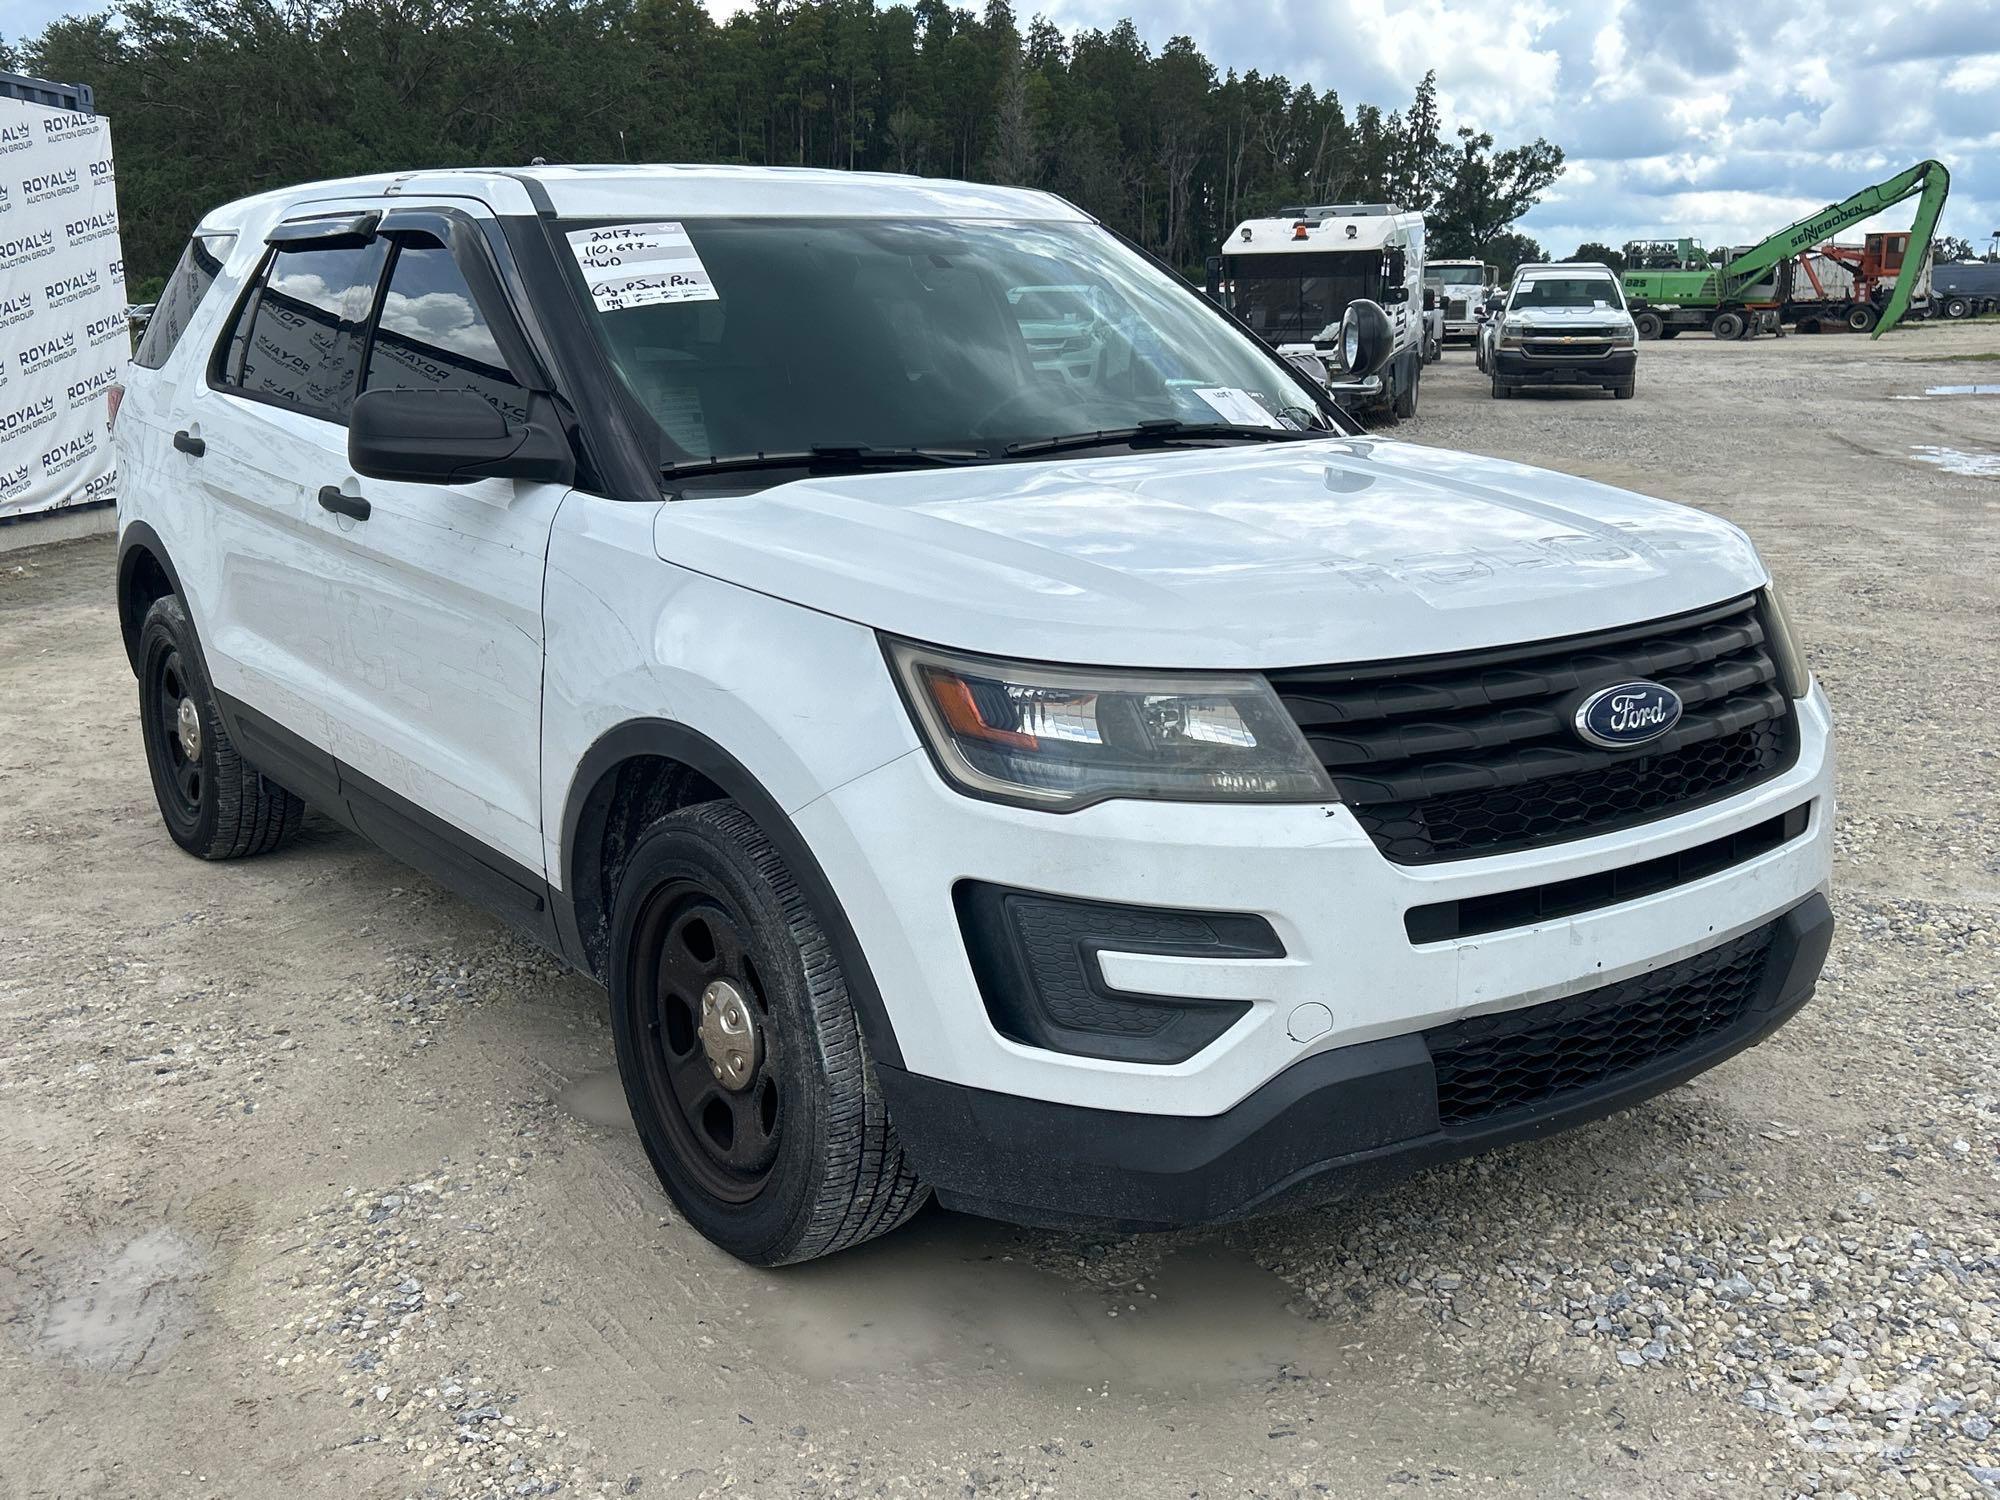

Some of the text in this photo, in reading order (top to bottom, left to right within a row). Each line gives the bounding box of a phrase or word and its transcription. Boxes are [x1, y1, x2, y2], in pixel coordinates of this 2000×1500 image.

[43, 113, 87, 133] ROYAL
[48, 126, 99, 143] AUCTION GROUP
[8, 140, 33, 153] GROUP
[89, 159, 115, 177] ROY
[93, 174, 115, 187] AUCTIO
[22, 172, 67, 195] ROYAL
[26, 184, 80, 206] AUCTION GROUP
[65, 214, 107, 238] ROYAL
[69, 225, 118, 248] AUCTION GROUP
[0, 234, 42, 259] ROYAL
[0, 246, 56, 271] AUCTION GROUP
[583, 256, 622, 268] 4WD
[45, 274, 88, 300] ROYAL
[49, 284, 101, 310] AUCTION GROUP
[9, 309, 35, 326] GROUP
[86, 312, 125, 338] ROYAL
[90, 329, 117, 348] AUCTION
[19, 338, 64, 367] ROYAL
[23, 347, 78, 377] AUCTION GROUP
[67, 372, 107, 400] ROYAL
[70, 392, 98, 410] AUCTION
[0, 403, 43, 432] ROYAL
[0, 411, 57, 444] AUCTION GROUP
[42, 437, 85, 468] ROYAL
[46, 444, 98, 478] AUCTION GROUP
[85, 470, 117, 497] ROYA
[1610, 691, 1666, 732] Ford
